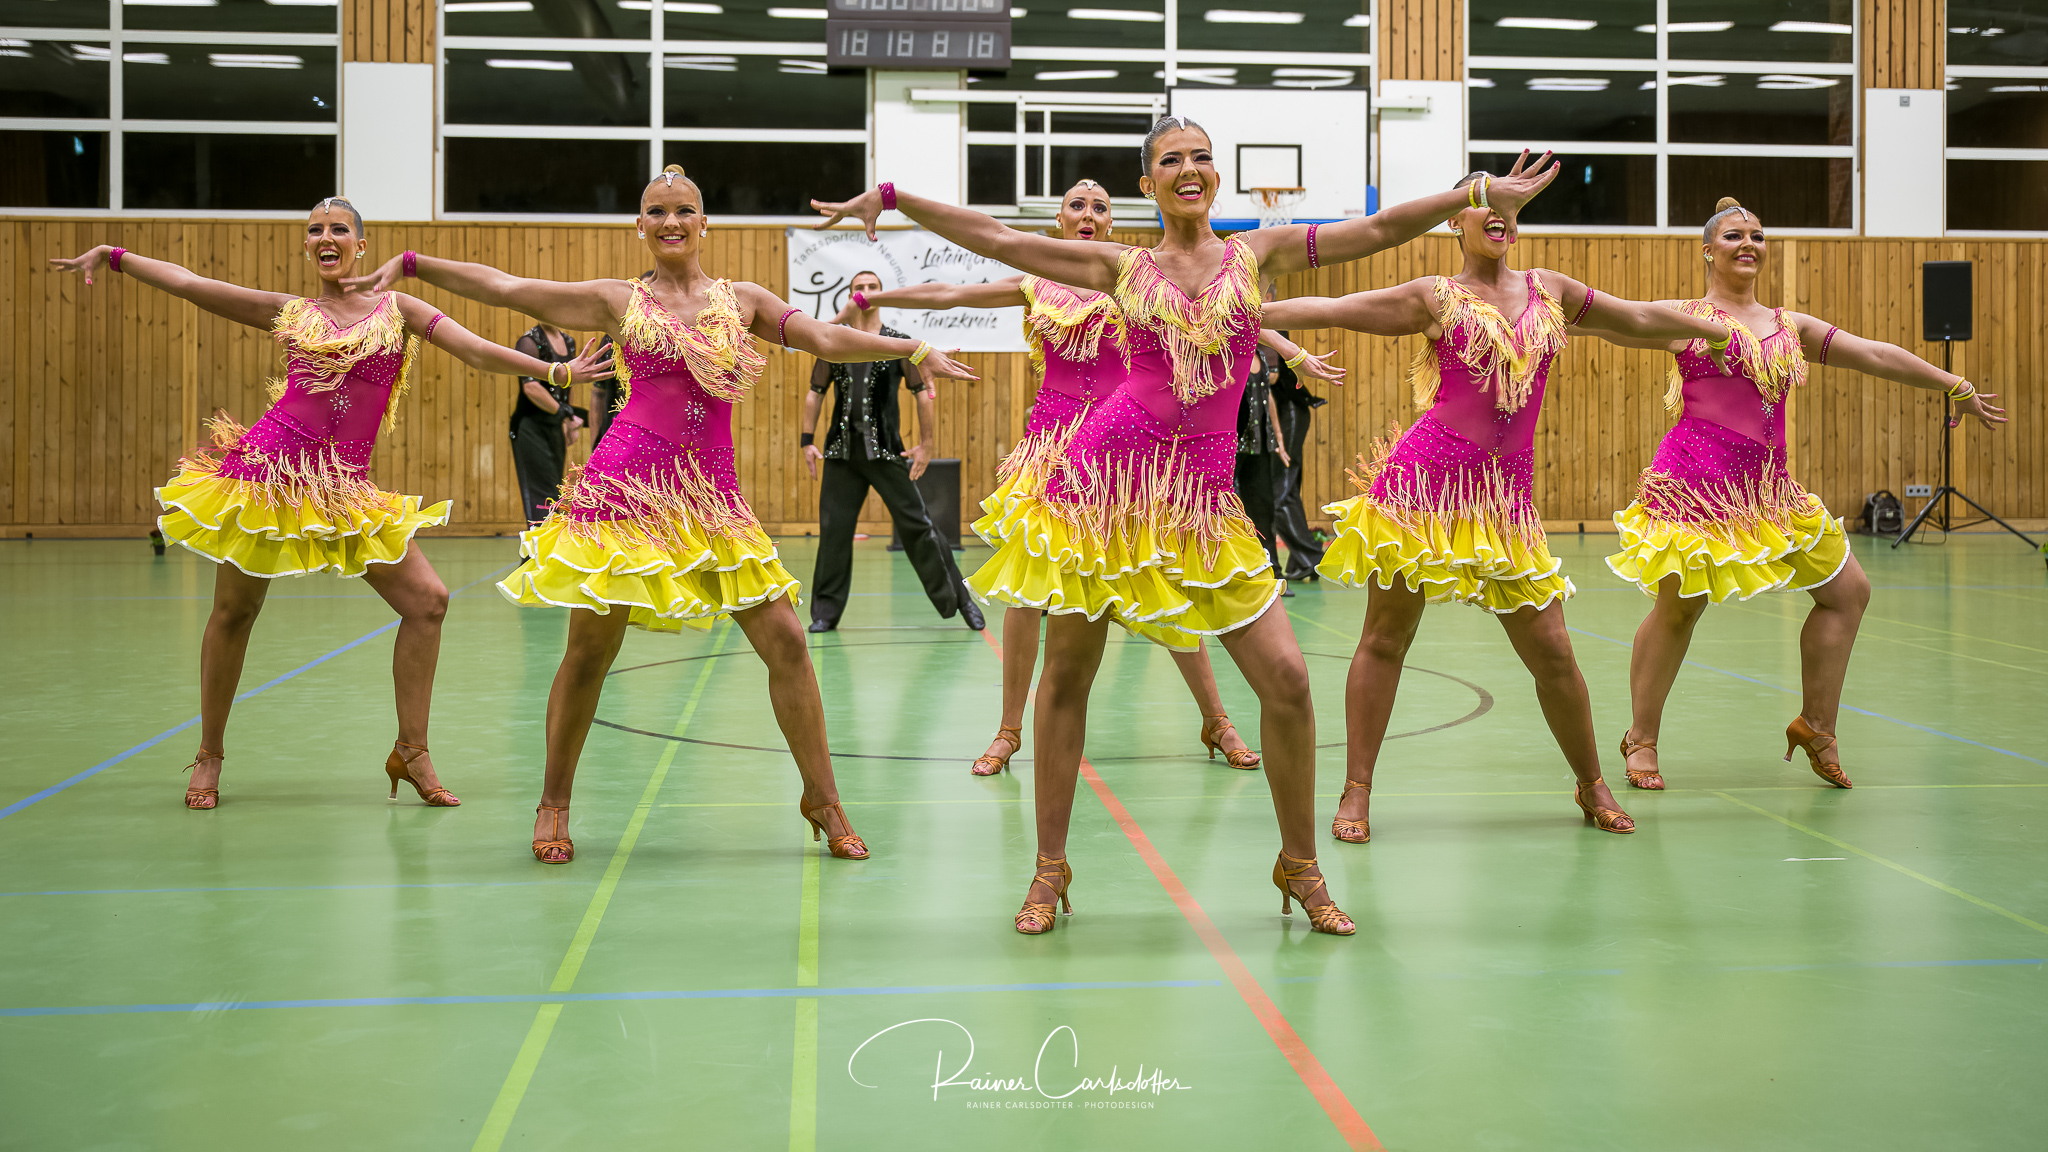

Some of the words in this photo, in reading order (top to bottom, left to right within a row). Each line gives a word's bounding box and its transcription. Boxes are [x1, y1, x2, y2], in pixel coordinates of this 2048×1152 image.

[841, 29, 868, 56] 18
[887, 30, 914, 57] 18
[967, 32, 994, 58] 18
[794, 232, 875, 266] Tanzsportclub
[921, 311, 998, 329] Tanzkreis
